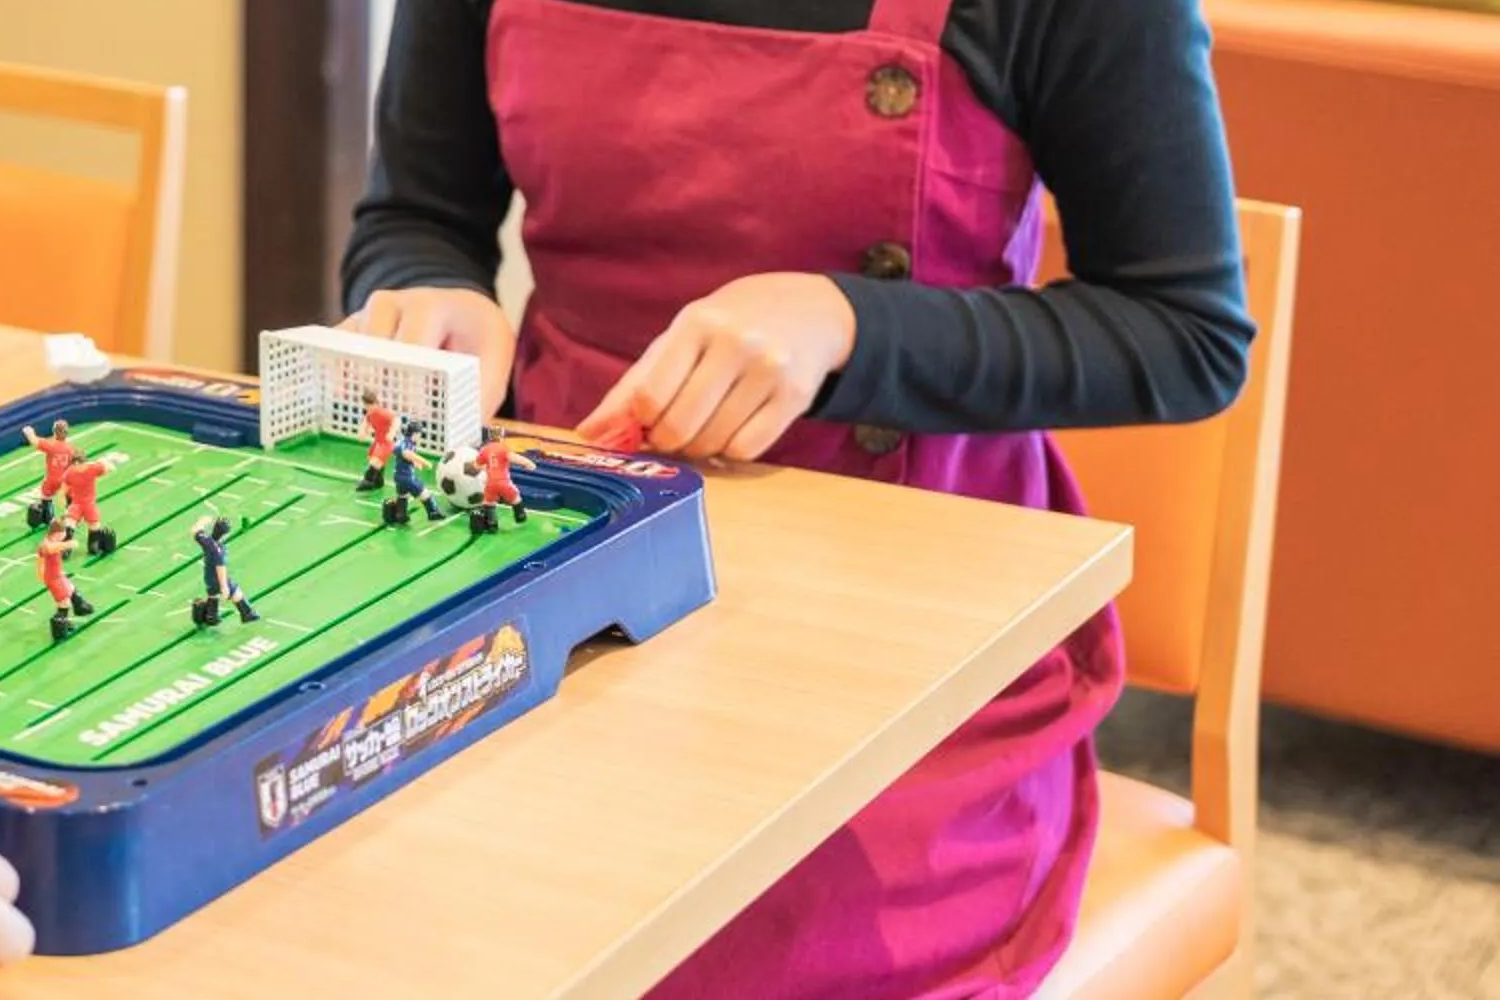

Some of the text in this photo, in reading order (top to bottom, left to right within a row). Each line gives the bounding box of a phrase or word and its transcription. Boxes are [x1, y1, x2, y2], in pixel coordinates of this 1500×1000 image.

[78, 636, 279, 746] SAMURAI BLUE
[288, 743, 341, 786] SAMURAI
[289, 772, 320, 800] BLUE
